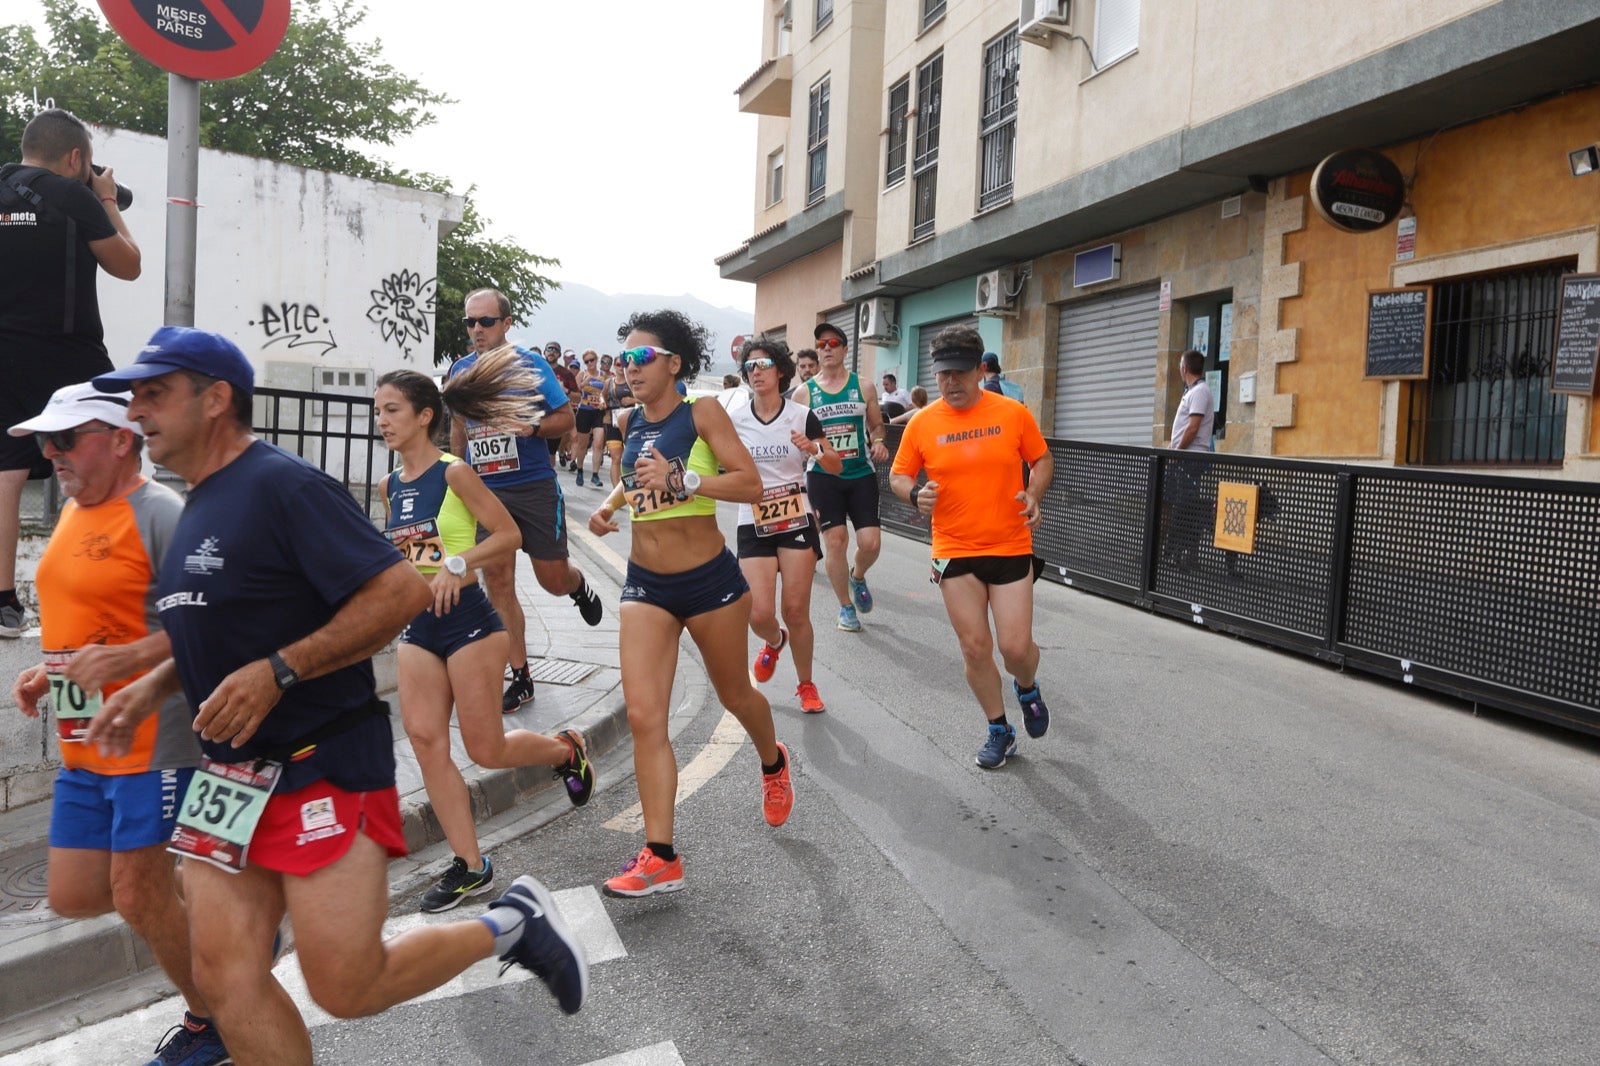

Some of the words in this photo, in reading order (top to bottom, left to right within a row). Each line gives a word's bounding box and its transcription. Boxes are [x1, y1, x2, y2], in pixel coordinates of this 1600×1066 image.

[157, 4, 207, 25] MESES
[157, 18, 203, 39] PARES
[817, 405, 833, 415] CAJA
[836, 403, 858, 411] RURAL
[947, 425, 1002, 443] MARCELINO
[474, 437, 511, 458] 3067
[760, 498, 800, 521] 2271
[188, 779, 254, 829] 357
